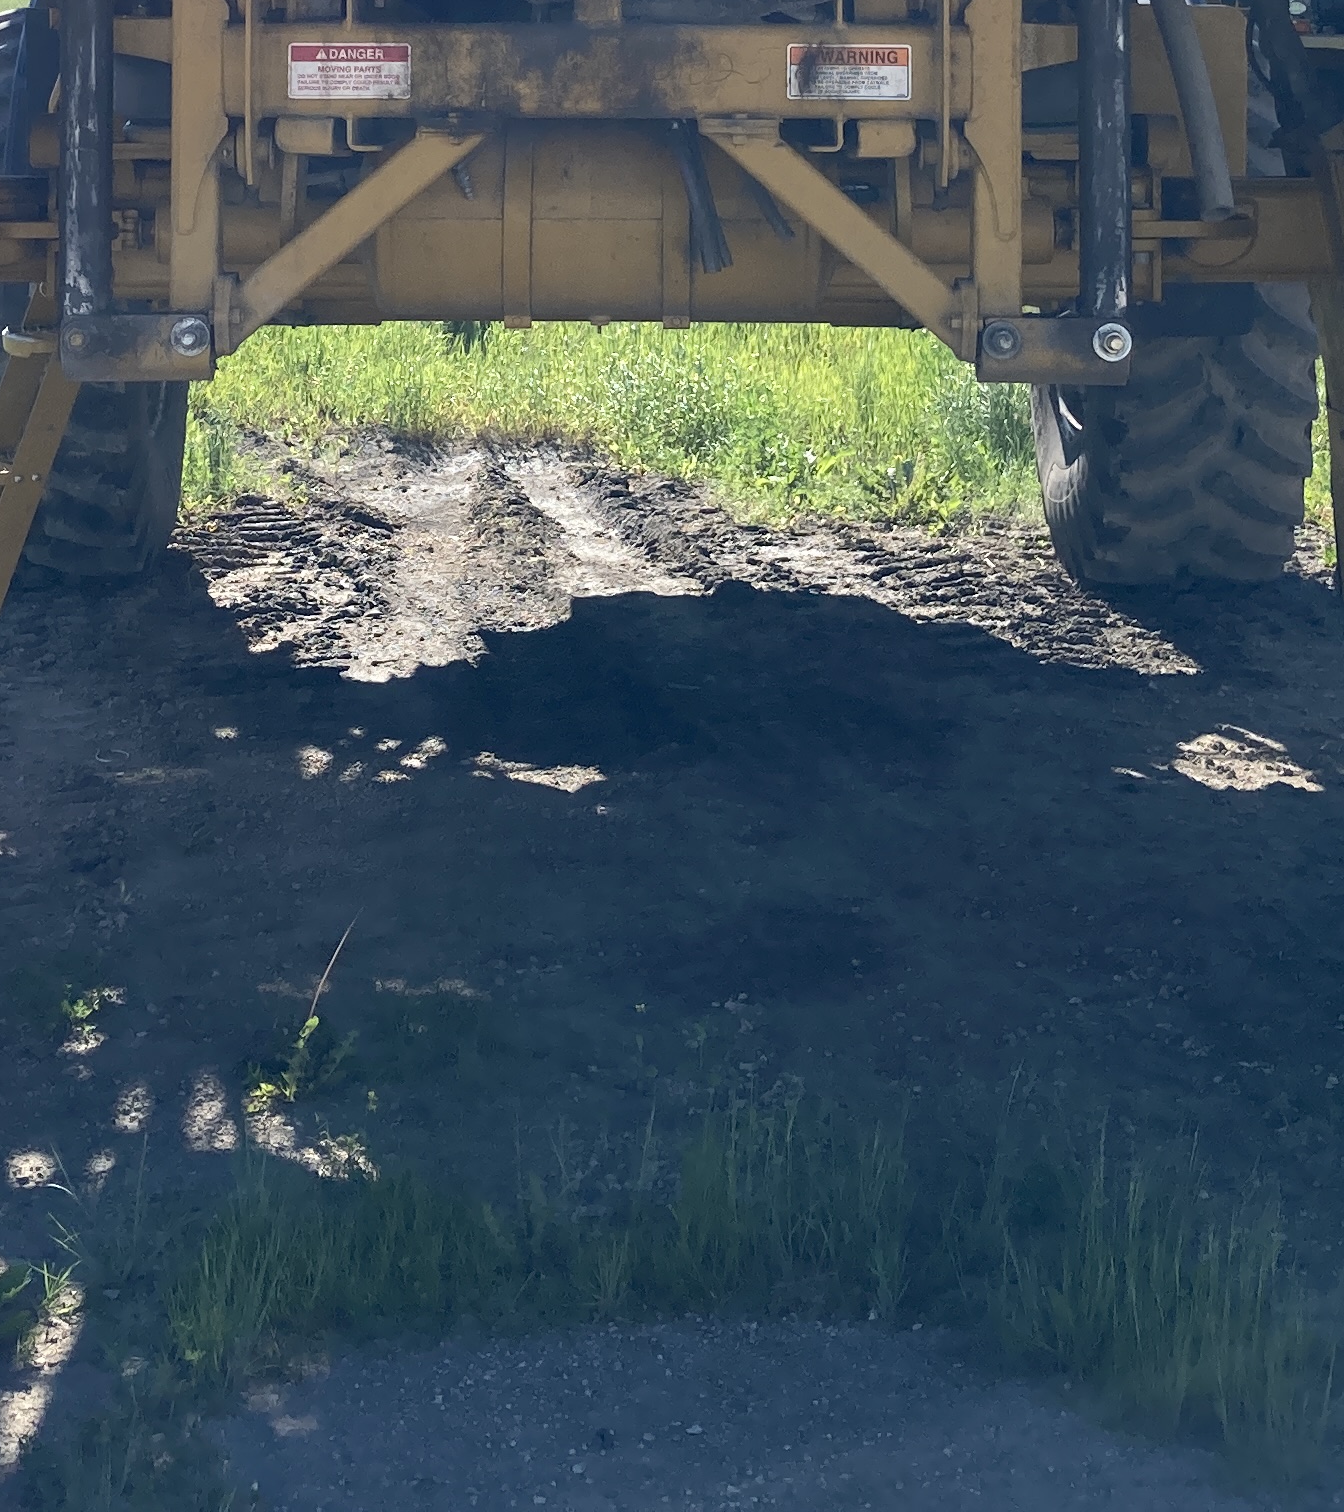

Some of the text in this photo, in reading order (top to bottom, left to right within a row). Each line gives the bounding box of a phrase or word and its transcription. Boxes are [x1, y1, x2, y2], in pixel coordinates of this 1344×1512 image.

[329, 48, 385, 60] DANGER
[821, 50, 898, 64] WARNING
[317, 65, 382, 73] MOVING PARTS
